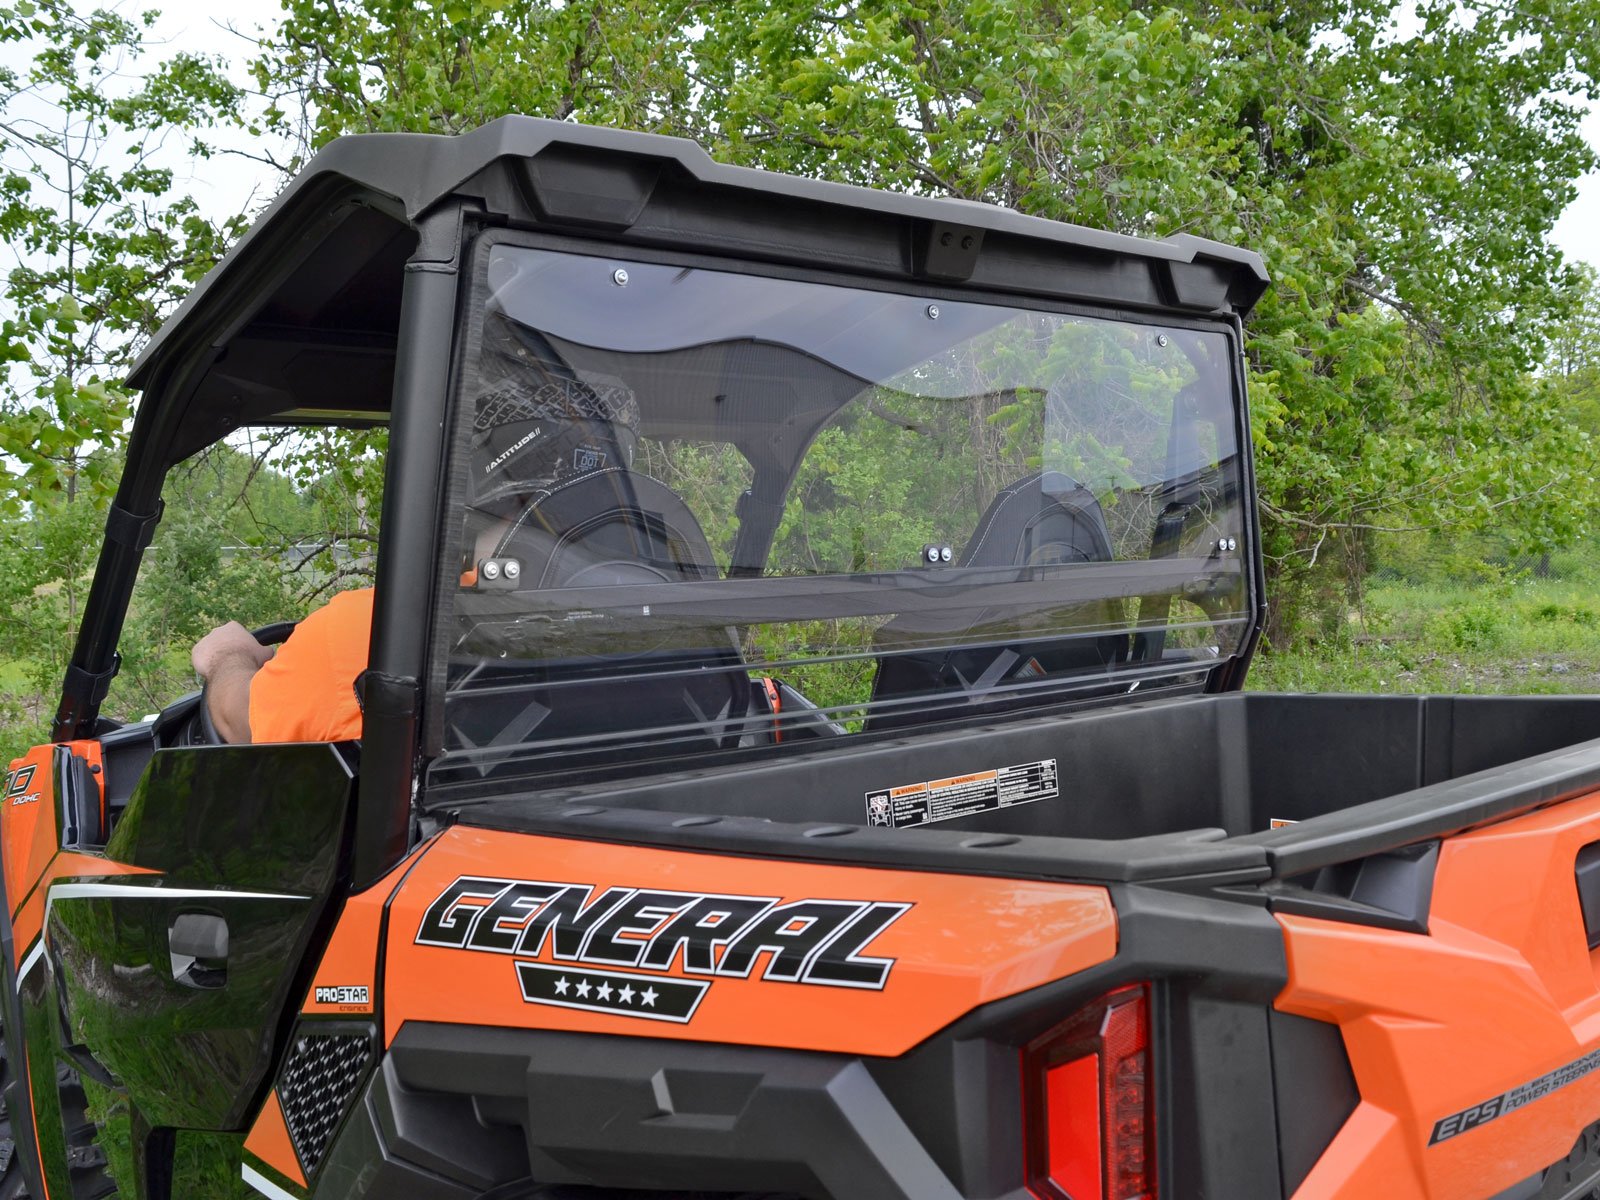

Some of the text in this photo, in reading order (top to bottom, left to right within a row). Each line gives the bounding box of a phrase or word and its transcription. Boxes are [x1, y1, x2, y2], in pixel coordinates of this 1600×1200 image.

[12, 793, 41, 805] DOHC
[414, 875, 916, 992] GENERAL
[315, 986, 369, 1003] PROSTAR
[1505, 1083, 1550, 1111] POWER
[1436, 1098, 1500, 1141] EPS
